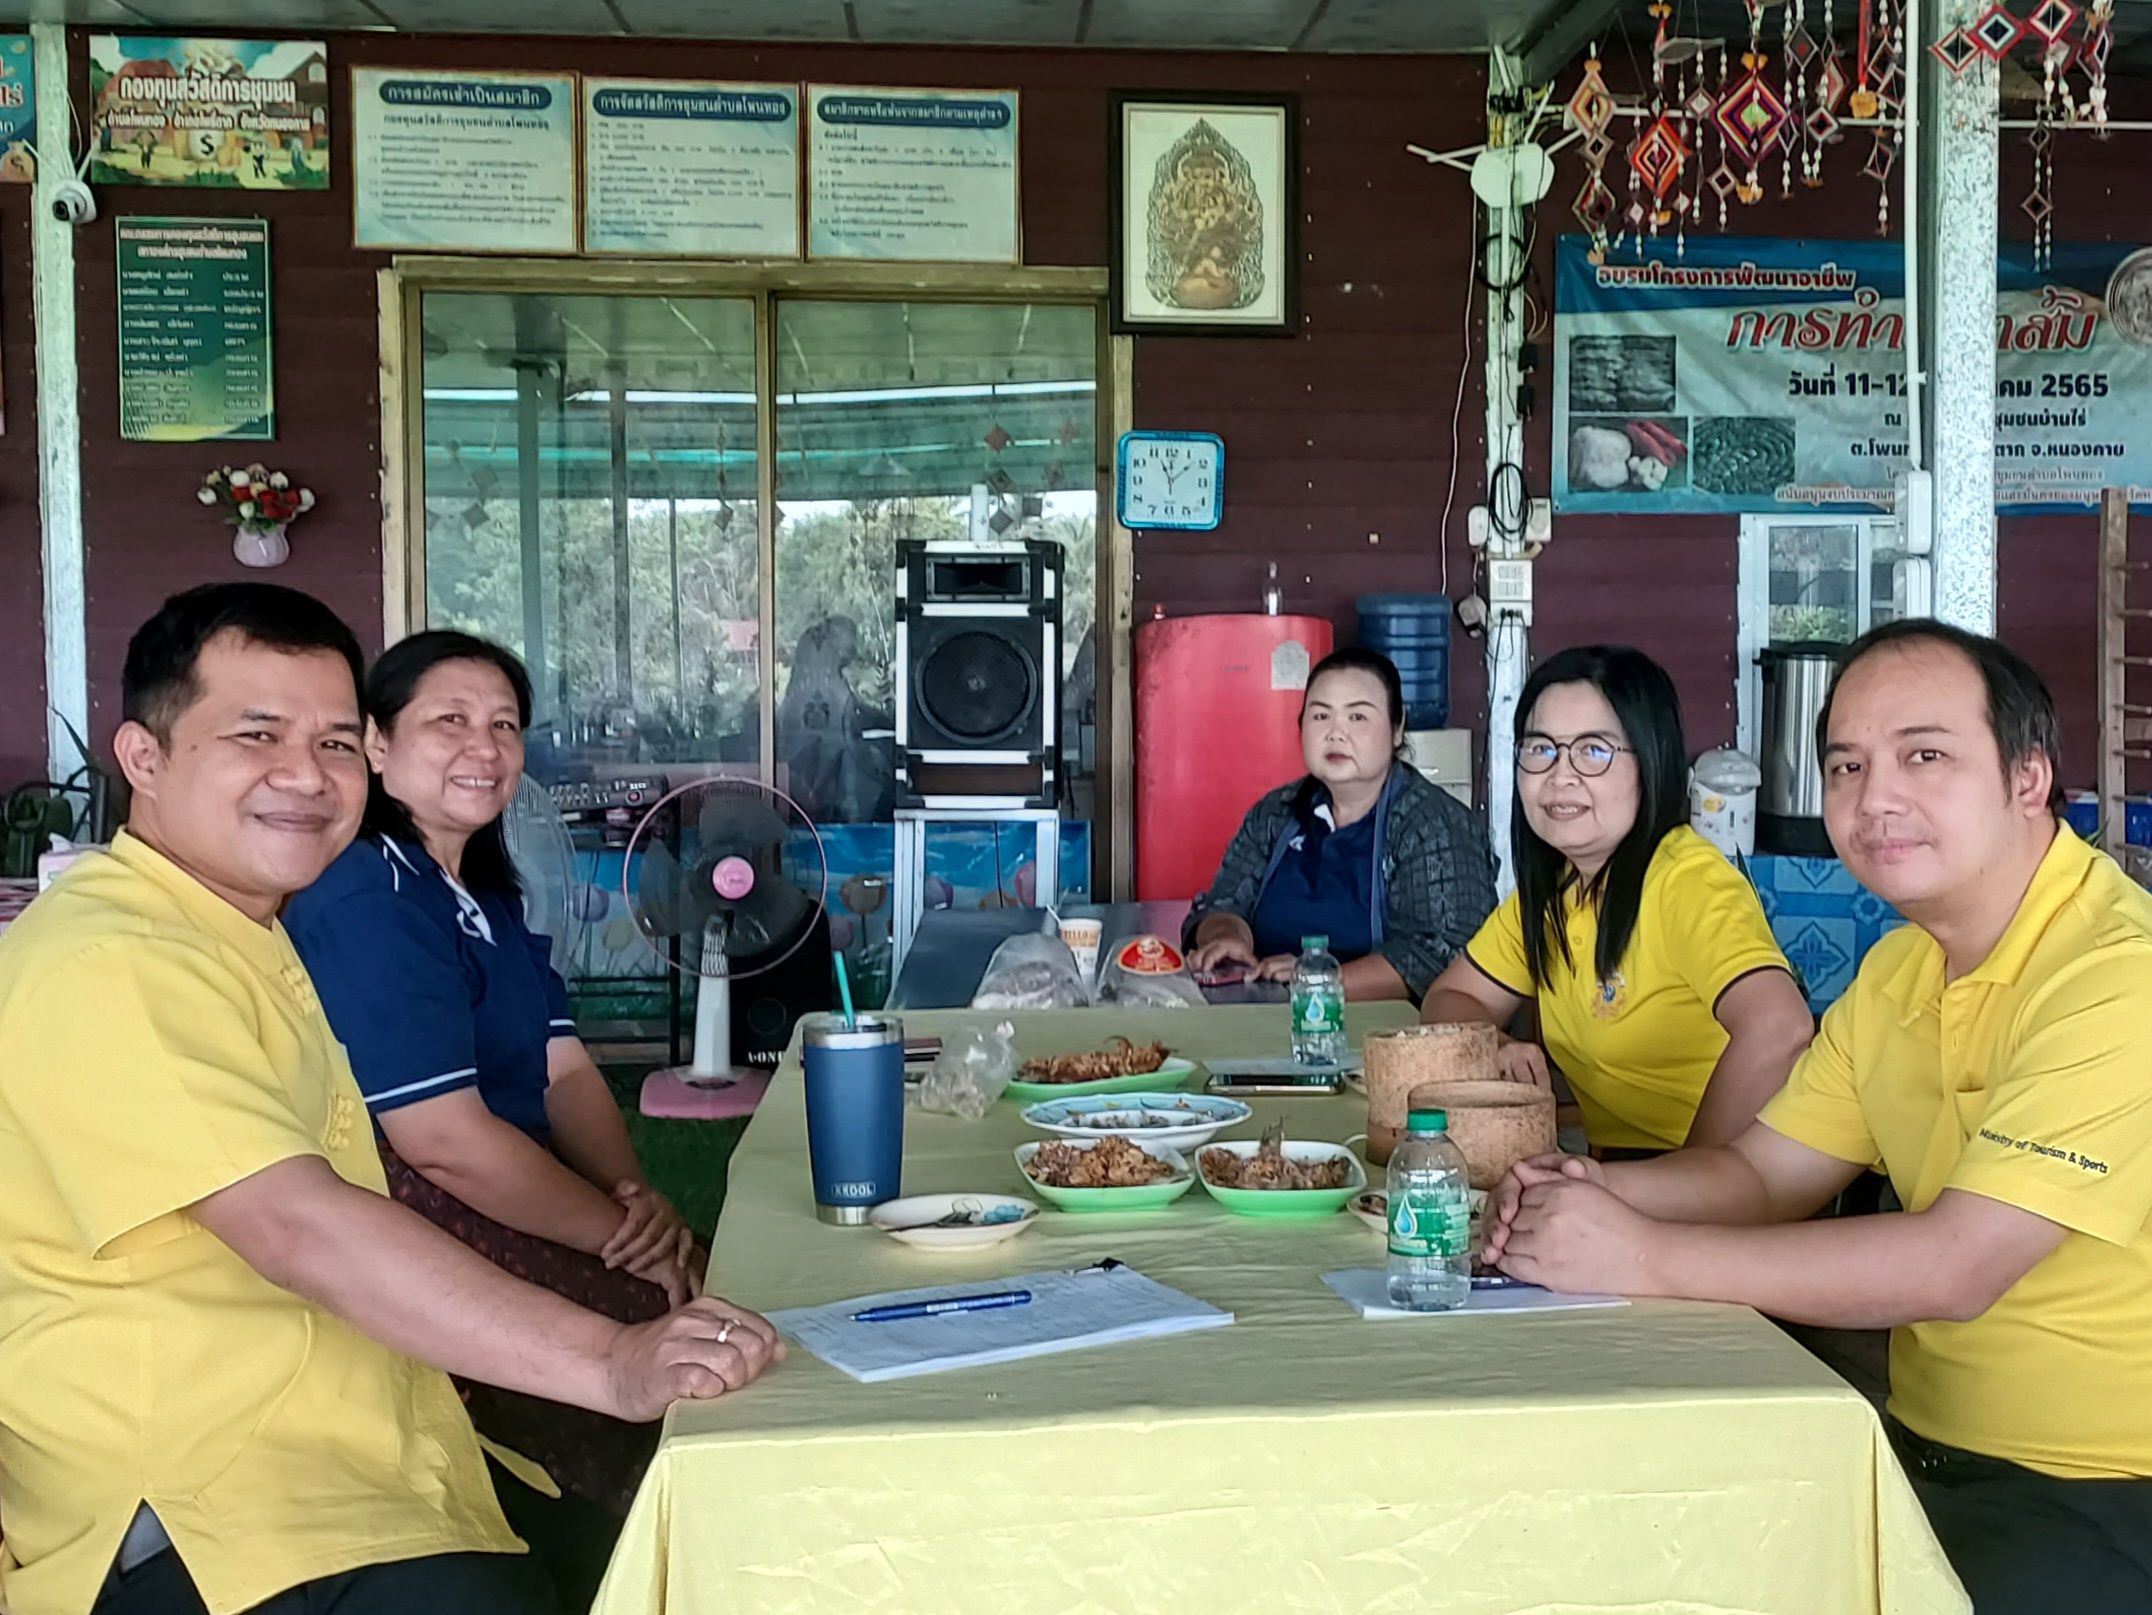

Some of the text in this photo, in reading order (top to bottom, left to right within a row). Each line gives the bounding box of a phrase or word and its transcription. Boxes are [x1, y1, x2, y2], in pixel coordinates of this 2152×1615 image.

[1598, 262, 1855, 290] อบรมโครงการพัฒนาอาชีพ
[1789, 363, 1836, 396] วันที่
[2041, 374, 2108, 398] 2565
[1884, 413, 1902, 426] ณ
[2031, 443, 2125, 457] จ.หนองคาย
[1979, 1127, 2109, 1174] Ministry of Tourism & Sports
